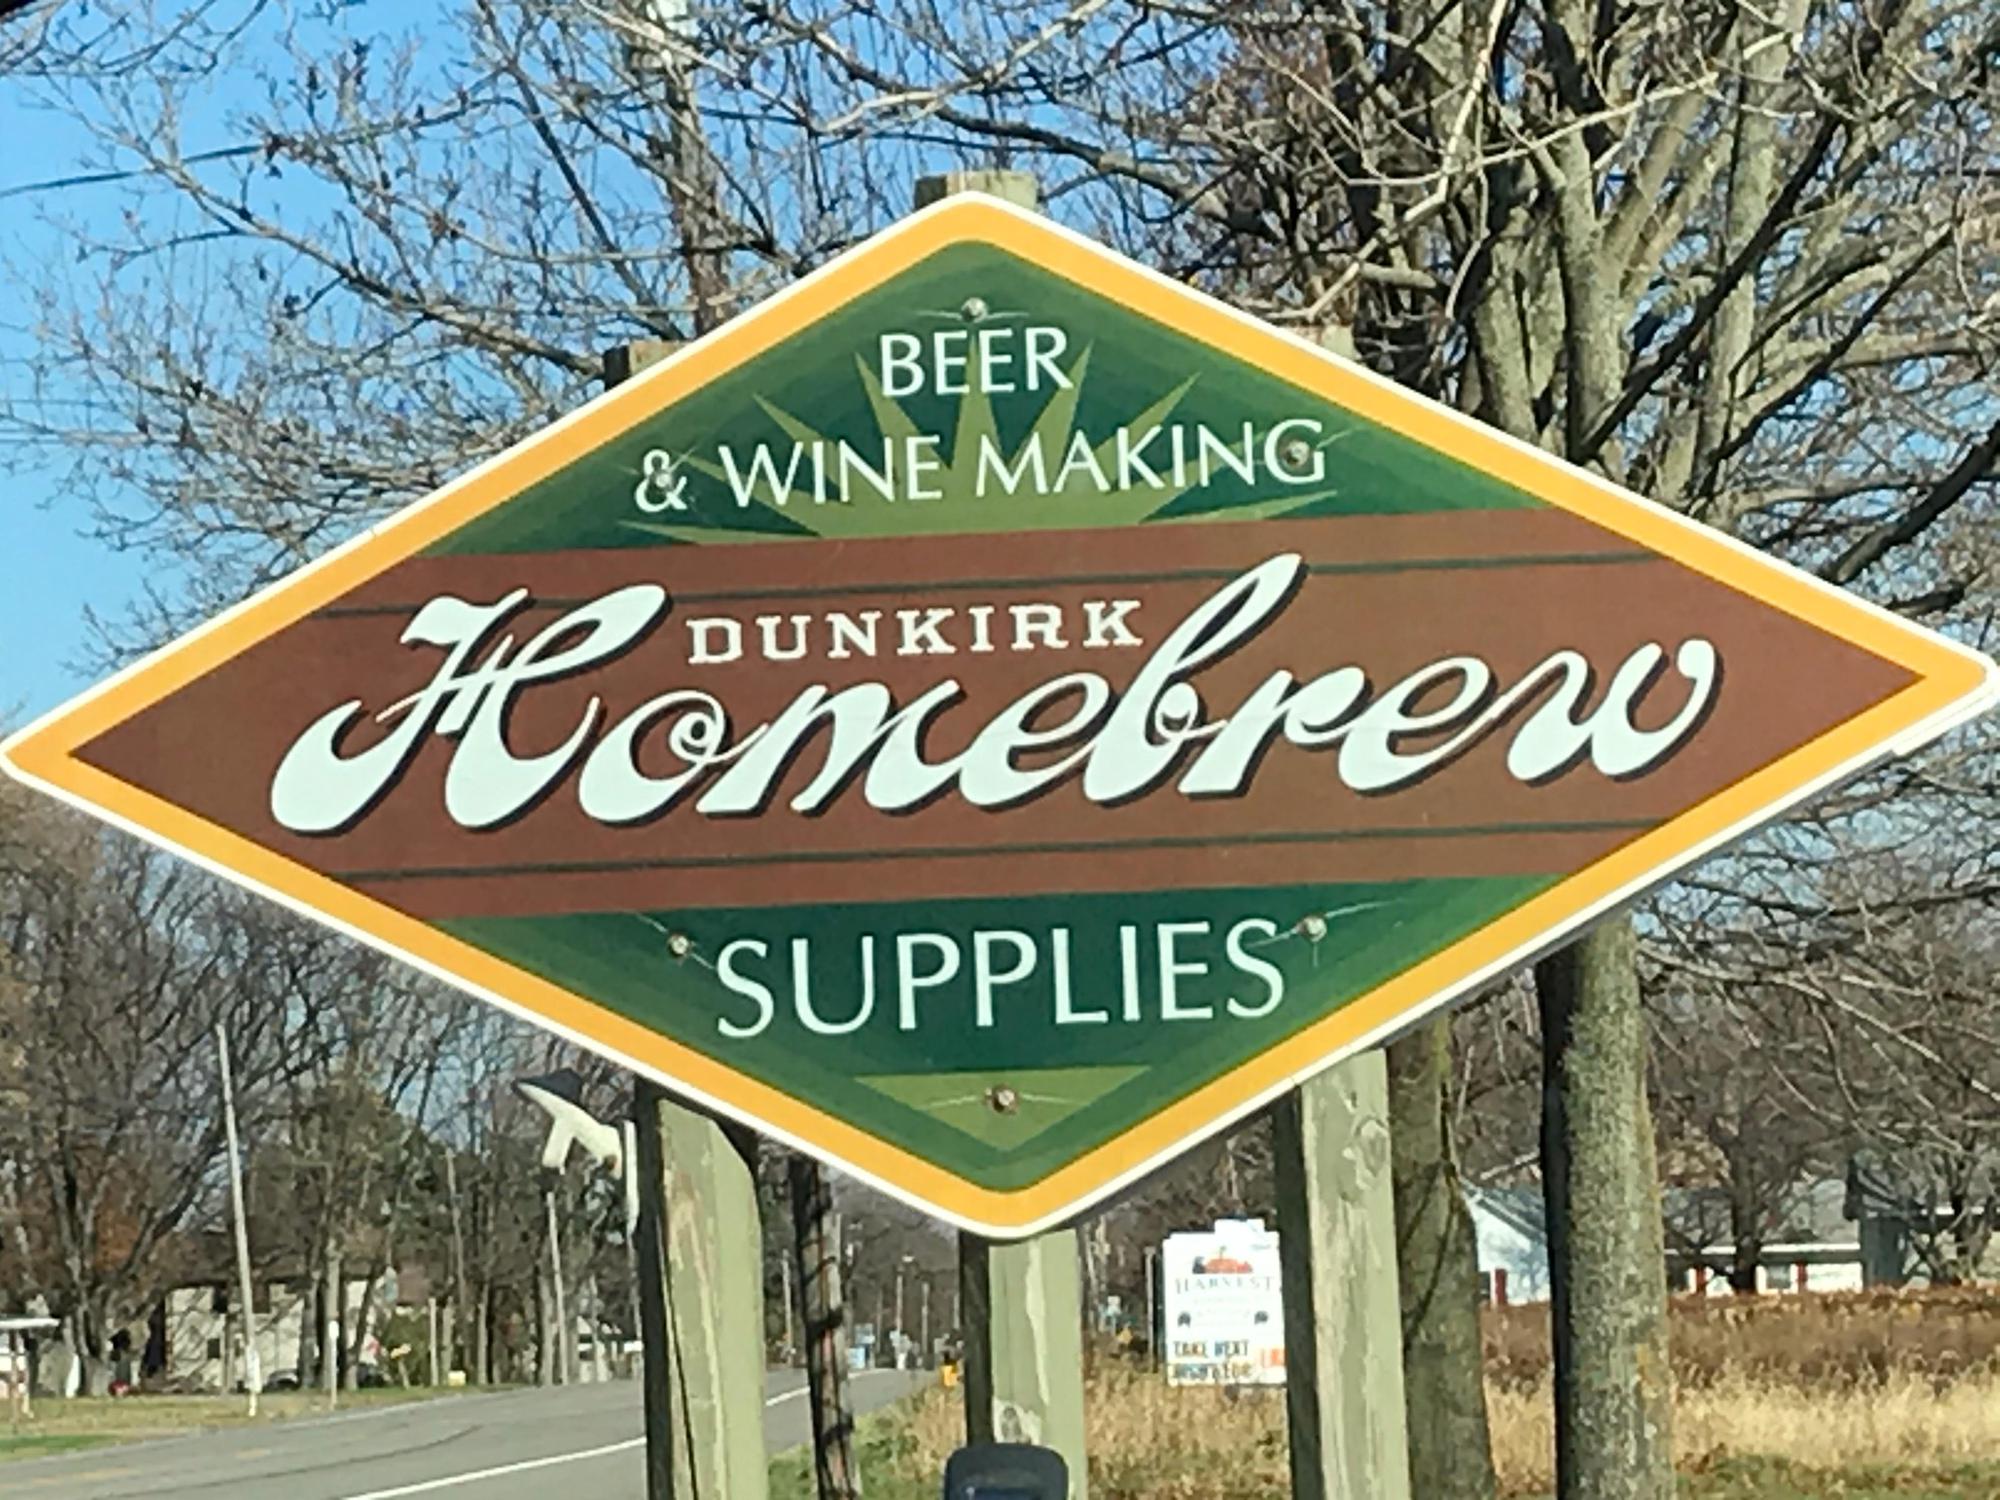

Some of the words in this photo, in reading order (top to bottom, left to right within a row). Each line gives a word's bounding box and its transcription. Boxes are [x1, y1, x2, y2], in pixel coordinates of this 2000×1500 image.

[880, 327, 1073, 397] BEER
[634, 449, 688, 514] &
[717, 434, 944, 508] WINE
[975, 419, 1327, 497] MAKING
[687, 600, 1143, 664] DUNKIRK
[272, 554, 1716, 832] Homebrew
[716, 919, 1283, 1037] SUPPLIES
